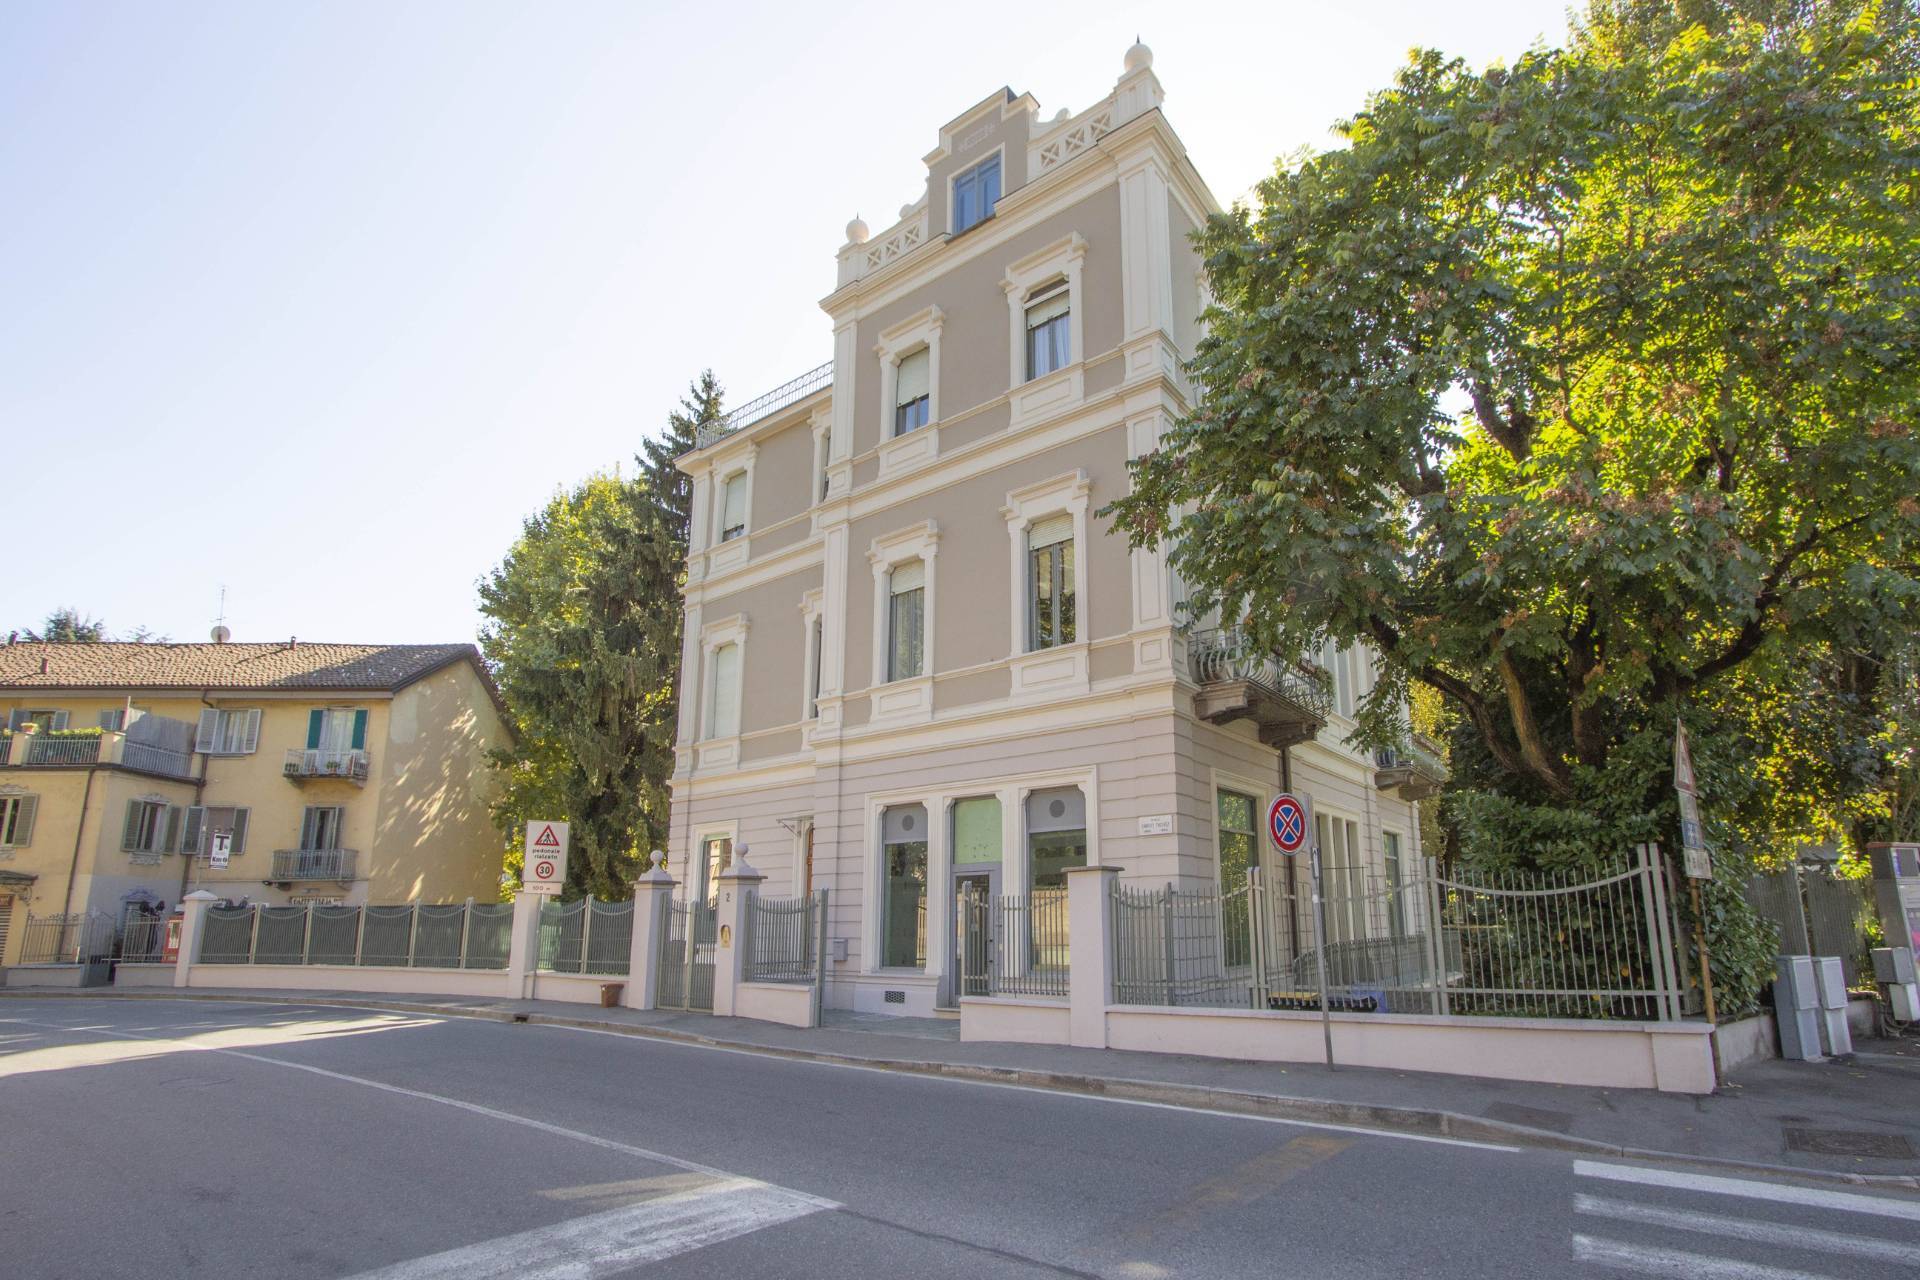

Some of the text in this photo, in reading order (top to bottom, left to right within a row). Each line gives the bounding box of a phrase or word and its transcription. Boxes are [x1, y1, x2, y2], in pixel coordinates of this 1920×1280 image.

[215, 835, 230, 851] T
[539, 866, 550, 874] 30
[726, 892, 731, 902] 2
